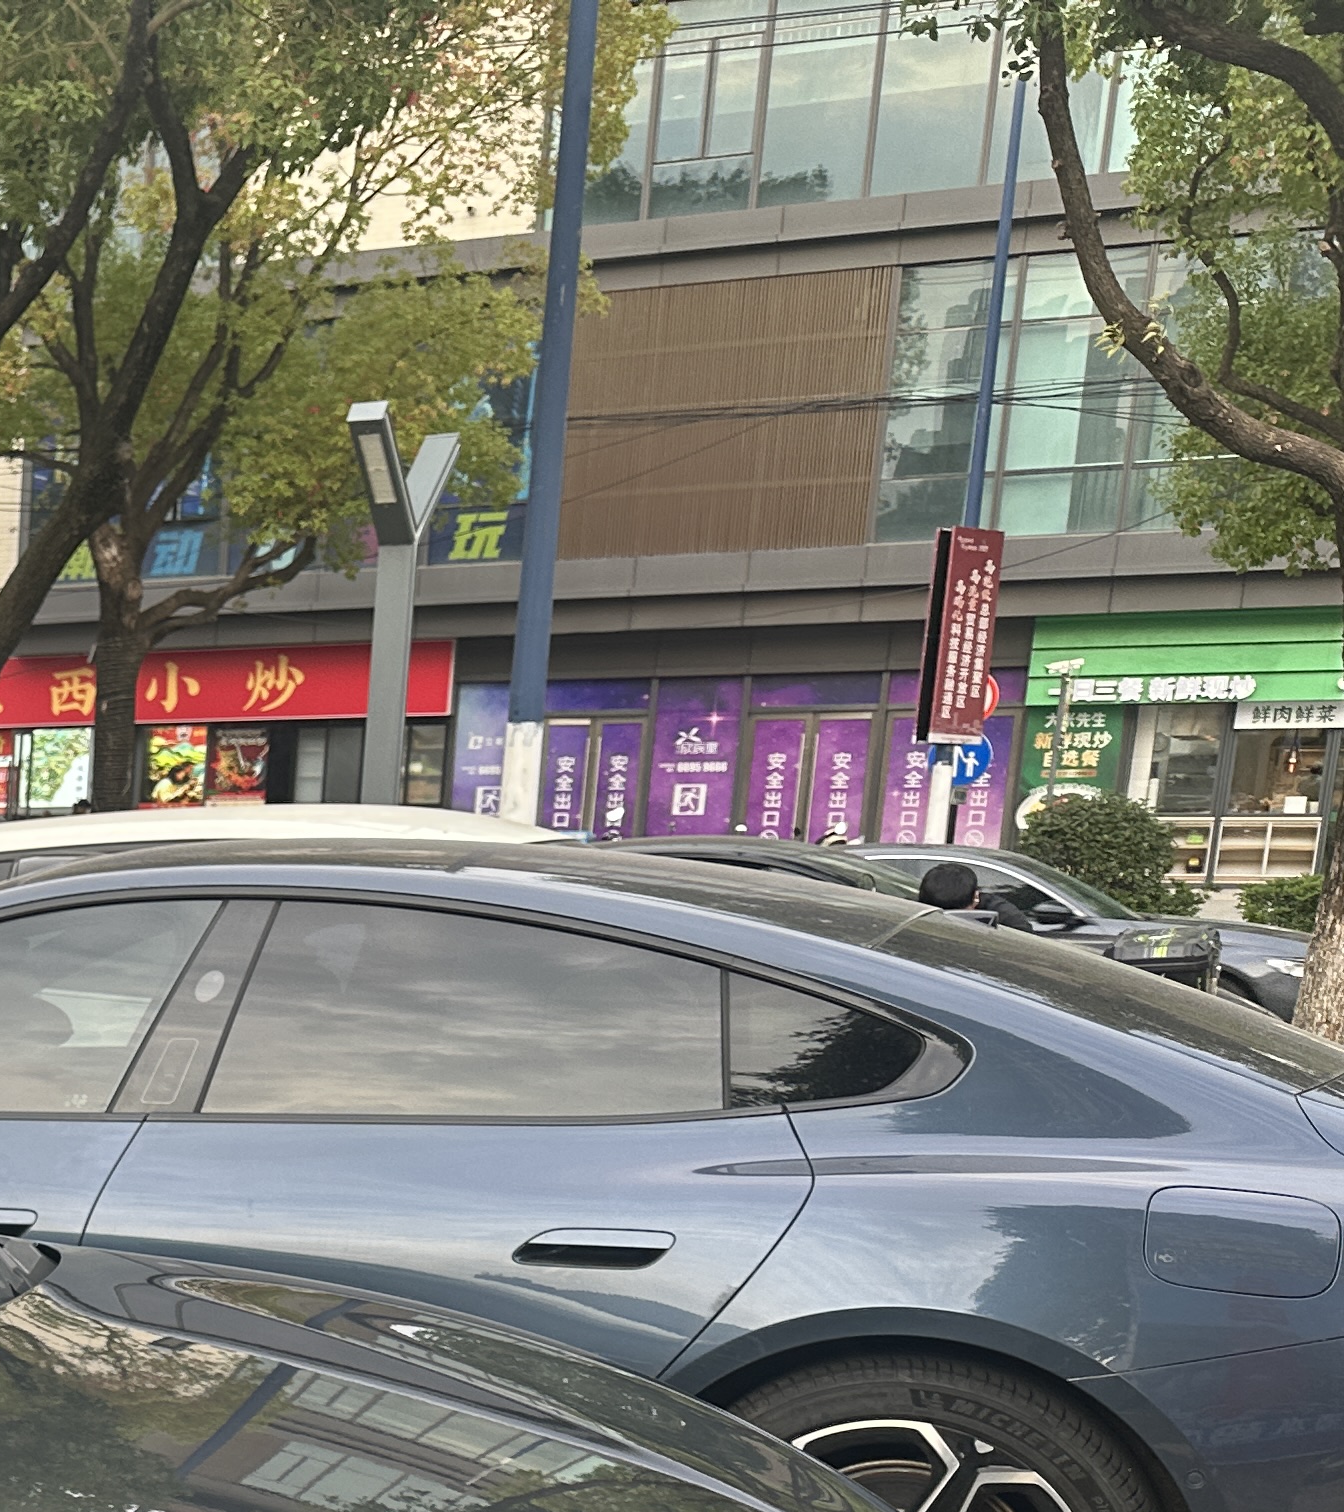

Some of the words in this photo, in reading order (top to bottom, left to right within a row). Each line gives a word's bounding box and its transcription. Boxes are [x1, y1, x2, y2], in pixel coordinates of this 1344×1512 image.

[448, 511, 510, 561] 玩
[1148, 674, 1257, 702] 新鲜现炒
[1251, 704, 1338, 724] 鲜肉鲜菜
[552, 755, 577, 829] 安全出口
[762, 751, 788, 828] 安全出口
[826, 751, 853, 829] 安全出口
[899, 750, 928, 827] 安全出口
[948, 1399, 1088, 1482] MICHELIN
